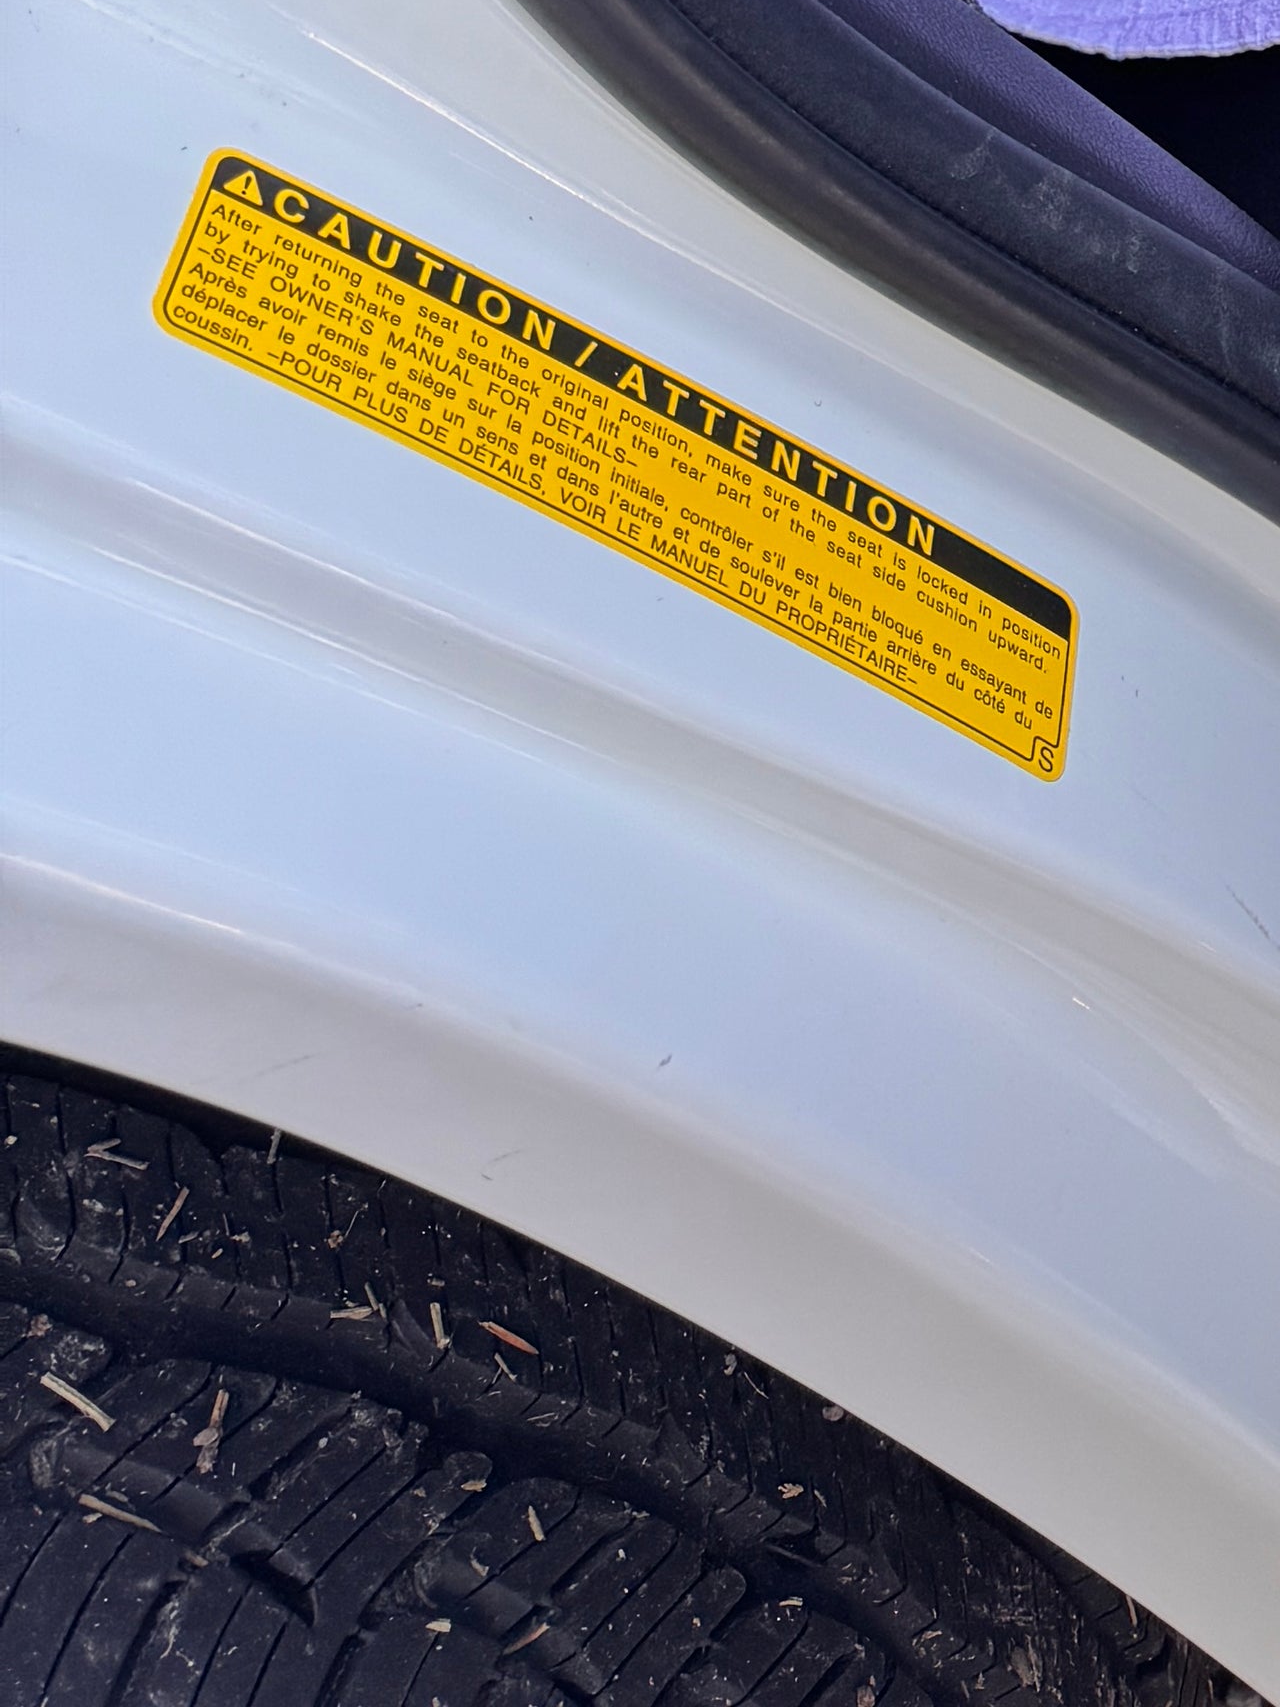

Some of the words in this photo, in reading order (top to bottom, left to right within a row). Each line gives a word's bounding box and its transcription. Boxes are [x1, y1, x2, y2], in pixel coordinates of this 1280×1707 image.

[172, 304, 253, 352] coussin.
[352, 385, 409, 424] PLUS
[417, 417, 450, 445] DE
[457, 436, 546, 497] DÉTAILS,
[560, 486, 607, 525] VOIR
[615, 516, 643, 542] LE
[649, 533, 729, 589] MANUEL
[738, 579, 767, 606] DU
[180, 283, 269, 332] déplacer
[277, 324, 296, 346] le
[305, 342, 378, 384] dossier
[385, 380, 433, 412] dans
[441, 407, 466, 430] un
[475, 425, 520, 456] sens
[528, 452, 548, 471] et
[556, 465, 600, 497] dans
[672, 526, 691, 545] et
[698, 538, 721, 559] de
[729, 555, 801, 601] soulever
[808, 593, 824, 616] la
[831, 610, 878, 644] partie
[885, 639, 938, 676] arrière
[945, 671, 966, 692] du
[973, 687, 1006, 715] côté
[1013, 709, 1033, 731] du
[187, 261, 248, 300] Après
[257, 296, 308, 327] avoir
[316, 323, 370, 358] remis
[379, 350, 398, 371] le
[406, 367, 457, 401] siège
[466, 397, 498, 420] sur
[505, 412, 523, 436] la
[530, 430, 601, 475] position
[609, 466, 669, 513] initiale,
[679, 506, 755, 553] contrôler
[794, 567, 820, 591] est
[827, 581, 863, 614] bien
[870, 604, 924, 646] bloqué
[931, 642, 952, 662] en
[959, 657, 1028, 706] essayant
[1034, 699, 1054, 720] de
[203, 220, 231, 246] by
[242, 239, 300, 280] trying
[311, 272, 332, 293] to
[342, 290, 402, 327] shake
[414, 322, 445, 349] the
[455, 346, 542, 399] seatback
[551, 395, 588, 422] and
[597, 415, 621, 440] lift
[631, 433, 660, 460] the
[670, 456, 708, 484] rear
[715, 481, 752, 509] part
[761, 505, 781, 523] of
[789, 517, 816, 543] the
[825, 540, 863, 570] seat
[871, 565, 907, 592] side
[916, 589, 978, 633] cushion
[987, 629, 1047, 674] upward.
[210, 203, 263, 236] After
[273, 233, 363, 289] returning
[375, 281, 406, 307] the
[417, 305, 460, 335] seat
[470, 328, 489, 349] to
[500, 343, 530, 370] the
[541, 367, 610, 412] original
[618, 407, 693, 459] position,
[705, 453, 753, 487] make
[762, 484, 801, 513] sure
[810, 507, 838, 533] the
[846, 530, 883, 559] seat
[892, 551, 907, 572] is
[916, 564, 969, 607] locked
[977, 599, 993, 620] in
[1001, 616, 1061, 661] position
[275, 189, 557, 352] CAUTION
[575, 342, 599, 369] /
[618, 364, 936, 557] ATTENTION
[386, 330, 474, 388] MANUAL
[486, 380, 531, 416] FOR
[1037, 745, 1055, 773] S
